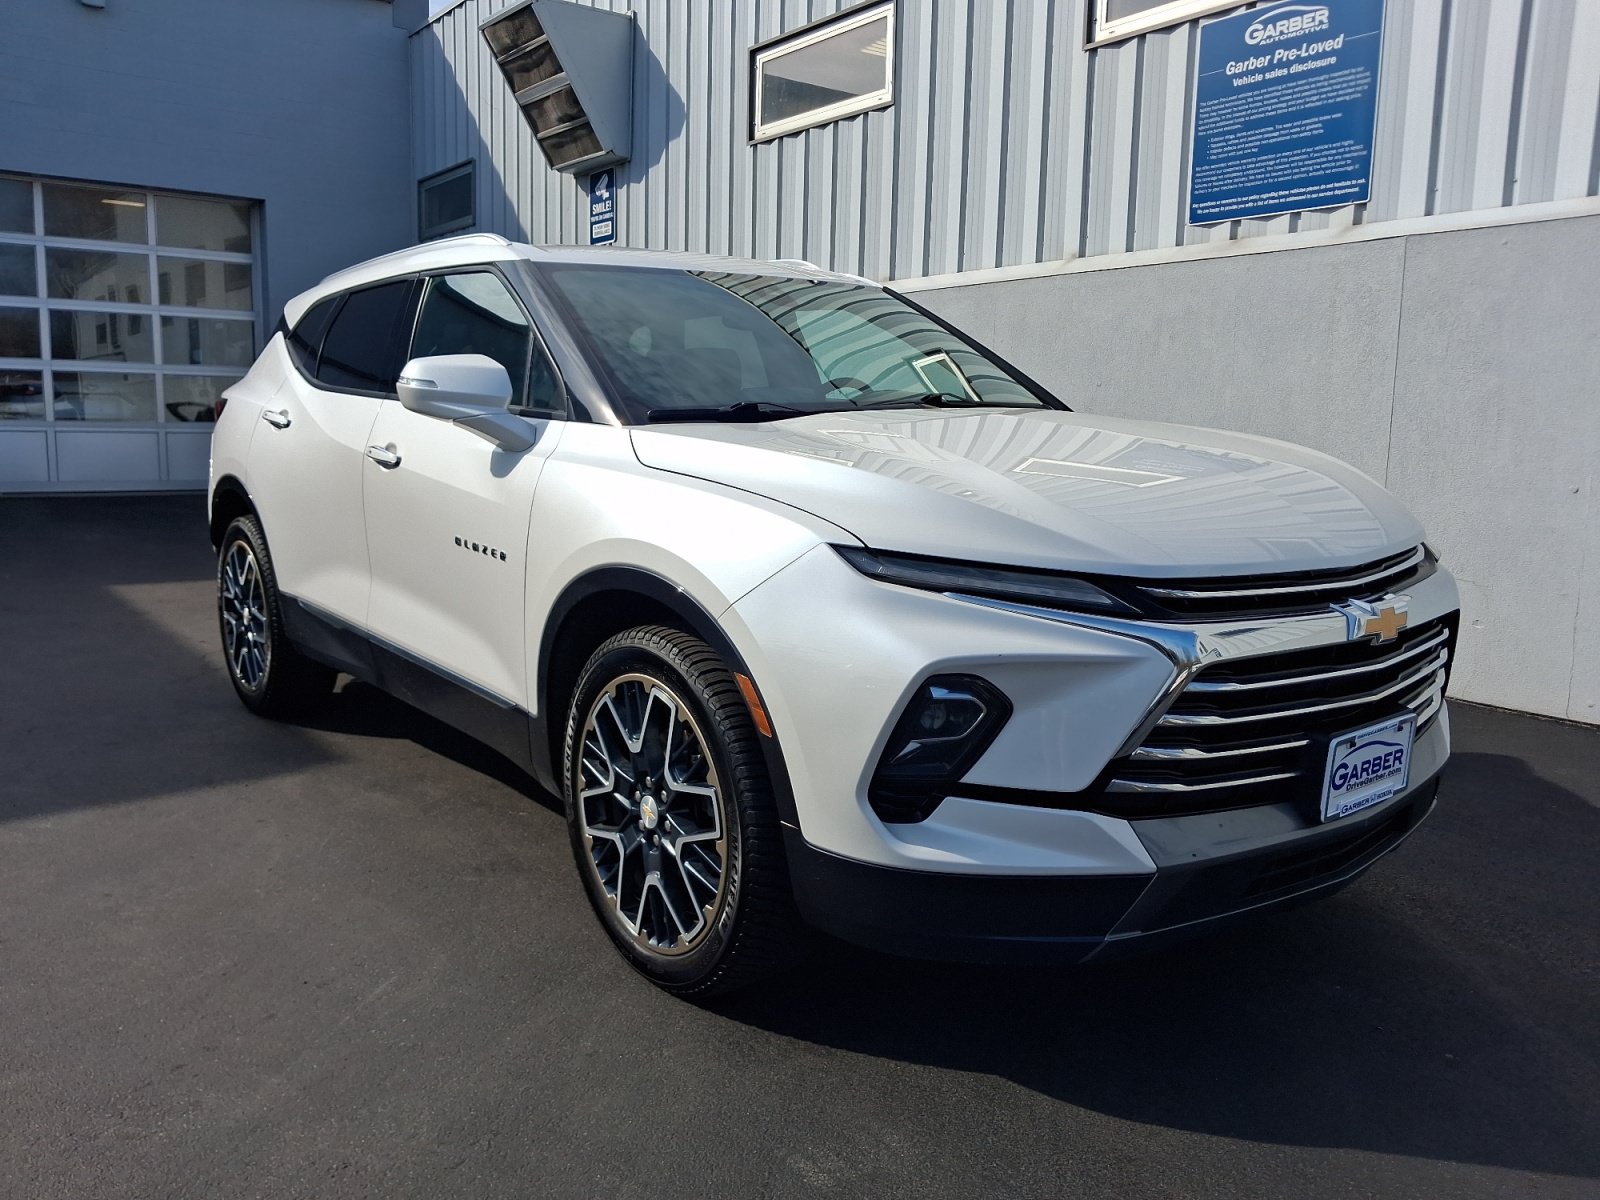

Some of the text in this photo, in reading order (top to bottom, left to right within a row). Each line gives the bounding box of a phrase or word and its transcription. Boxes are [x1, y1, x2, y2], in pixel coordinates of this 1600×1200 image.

[1245, 10, 1329, 45] GARBER
[1259, 23, 1329, 46] AUTOMOTIVE
[1226, 33, 1344, 75] Garber Pre-Loved
[1232, 56, 1337, 87] Vehicle sales disclosure
[454, 536, 507, 562] BLAZER
[1331, 748, 1404, 791] GARBER
[1346, 767, 1402, 791] DriveGarber.com
[1341, 798, 1370, 814] GARBER
